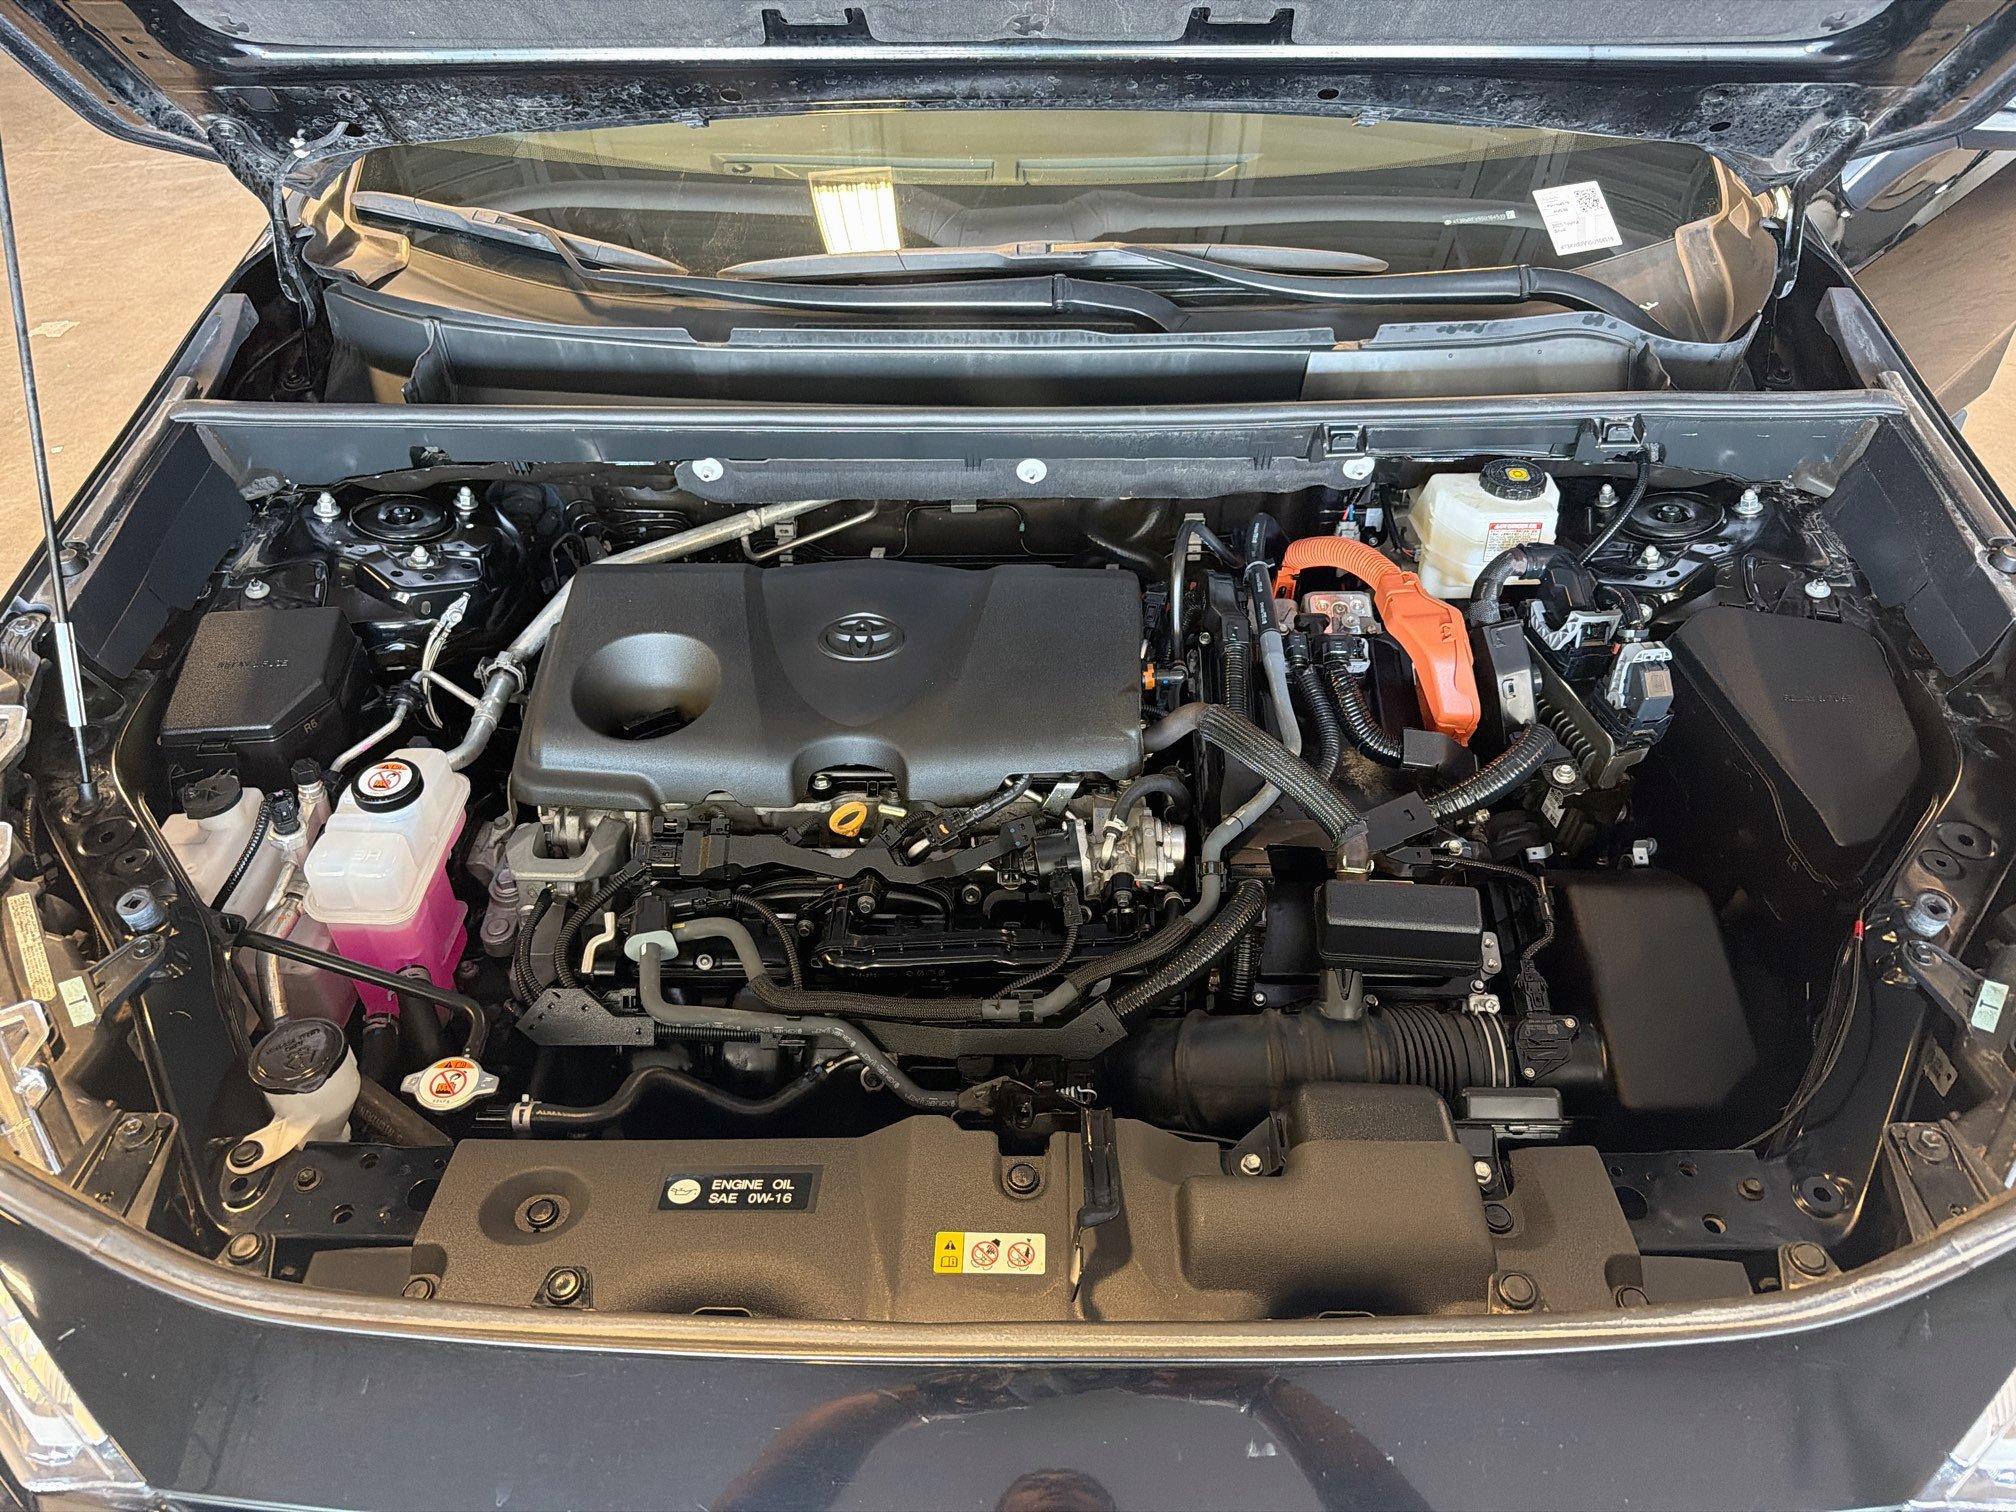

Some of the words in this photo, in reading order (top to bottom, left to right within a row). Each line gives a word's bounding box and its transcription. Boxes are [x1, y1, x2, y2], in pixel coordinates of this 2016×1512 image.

[303, 719, 318, 734] R6
[68, 994, 88, 1006] T
[1978, 998, 1999, 1011] T
[711, 1179, 764, 1190] ENGINE
[772, 1179, 795, 1190] OIL
[708, 1193, 737, 1204] SAE
[747, 1193, 792, 1204] 0W-16
